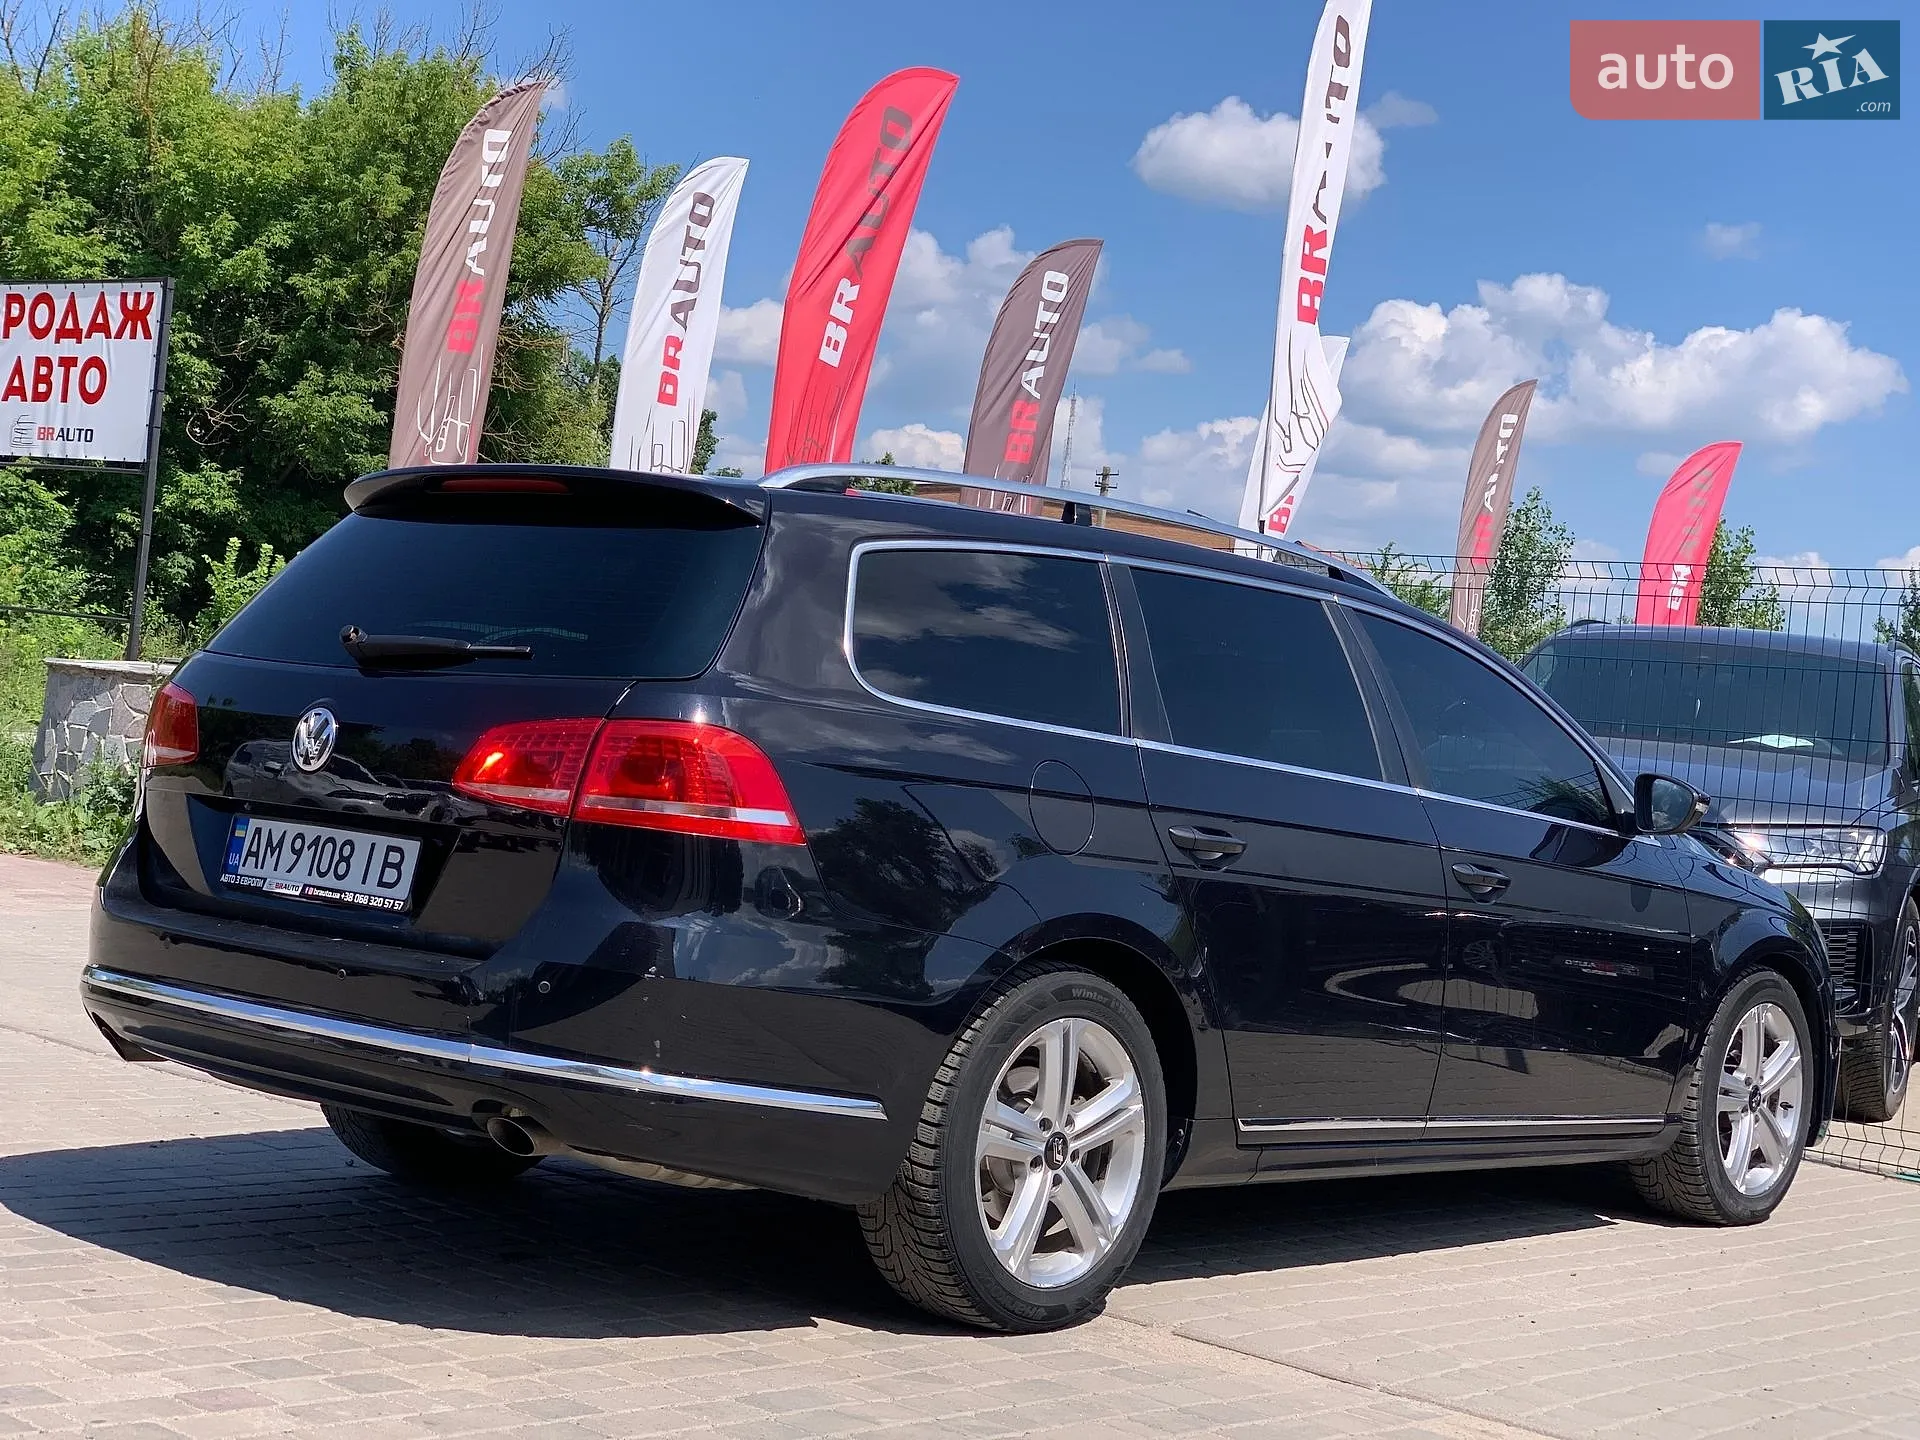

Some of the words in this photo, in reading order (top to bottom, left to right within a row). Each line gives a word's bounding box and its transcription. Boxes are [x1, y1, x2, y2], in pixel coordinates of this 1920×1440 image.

[447, 129, 512, 353] BRAUTO
[819, 105, 913, 368] BRAUTO
[657, 192, 715, 406] BRAUTO
[1, 355, 107, 405] АВТО
[1004, 270, 1069, 464] BRAUTO
[37, 427, 94, 443] BRAUTO
[228, 853, 239, 866] UA
[242, 827, 287, 871] AM
[286, 832, 355, 881] 9108
[361, 842, 405, 890] IB
[275, 882, 300, 892] BRAUTO
[341, 892, 354, 901] +38
[368, 897, 383, 907] 320
[383, 899, 393, 908] 57
[393, 901, 404, 910] 57
